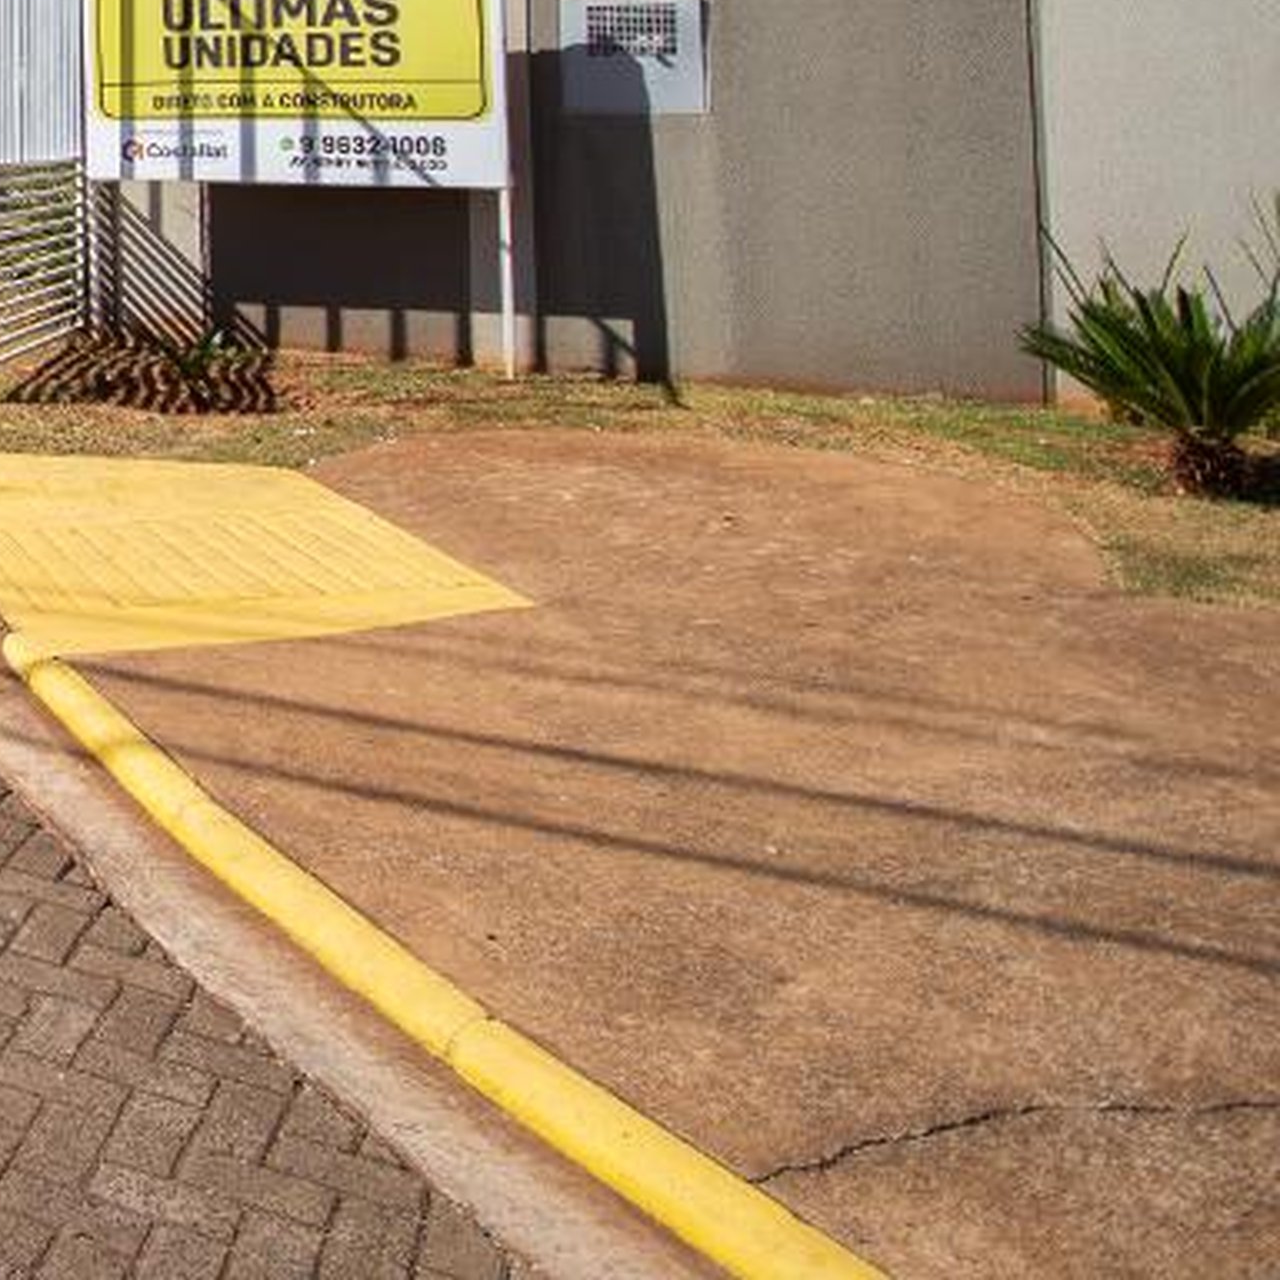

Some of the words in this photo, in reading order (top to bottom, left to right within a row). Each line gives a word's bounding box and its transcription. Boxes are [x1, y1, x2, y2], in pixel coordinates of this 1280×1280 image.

[162, 30, 402, 70] UNIDADES
[216, 92, 257, 109] COM
[261, 93, 276, 108] A
[279, 92, 418, 110] CONSTRUTORA
